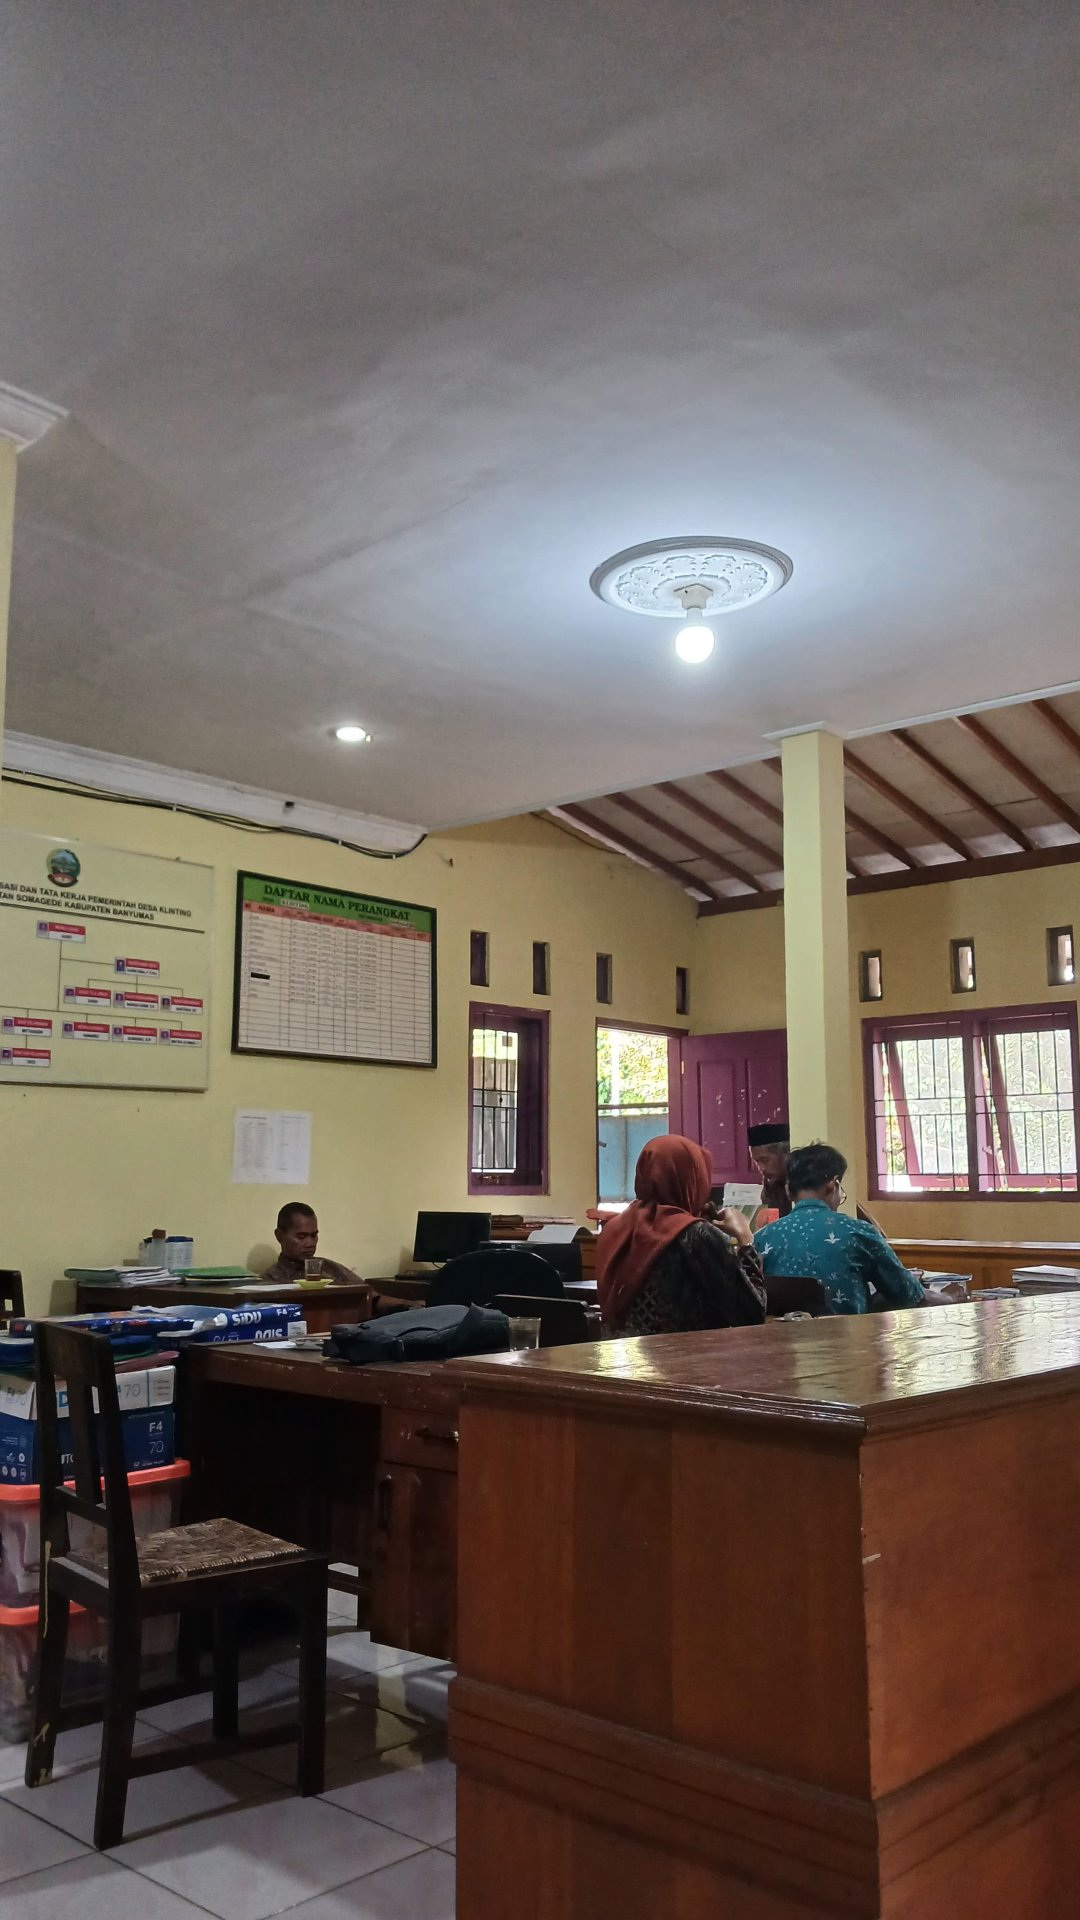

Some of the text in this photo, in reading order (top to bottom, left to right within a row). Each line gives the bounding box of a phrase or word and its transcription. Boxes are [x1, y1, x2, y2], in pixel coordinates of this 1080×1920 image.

[16, 894, 62, 907] SOMAGEDE
[64, 901, 111, 914] KABUPATEN
[113, 908, 154, 920] BANYUMAS
[20, 885, 37, 895] DAN
[40, 888, 58, 897] TATA
[61, 891, 86, 901] KERJA
[88, 895, 136, 909] PEMERINTAH
[138, 903, 157, 912] DESA
[160, 906, 192, 917] KLINTING
[264, 885, 310, 903] DAFTAR
[313, 894, 345, 909] NAMA
[348, 901, 411, 920] PERANGKAT
[124, 1383, 141, 1398] 70
[149, 1421, 163, 1433] F4
[149, 1440, 164, 1454] 70
